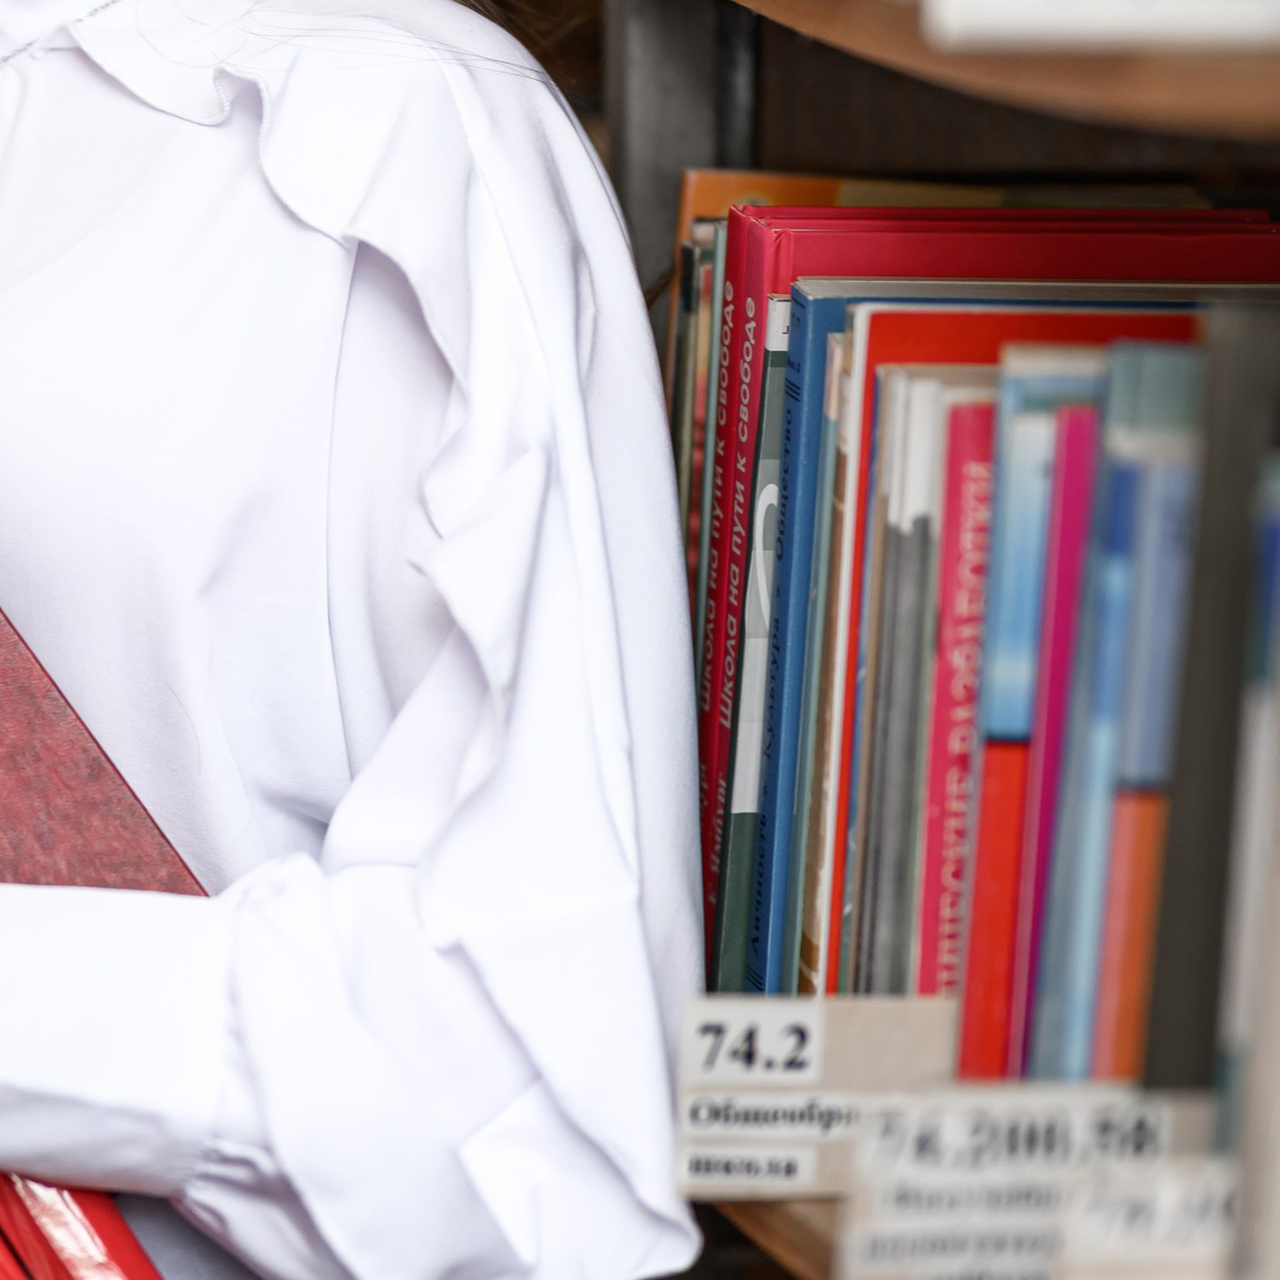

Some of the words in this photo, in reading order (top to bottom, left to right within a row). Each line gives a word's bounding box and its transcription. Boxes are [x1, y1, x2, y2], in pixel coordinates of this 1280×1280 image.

[738, 297, 757, 443] свободе
[731, 480, 746, 556] пути
[728, 563, 741, 607] на
[720, 613, 737, 729] Школа
[696, 1022, 811, 1071] 74.2
